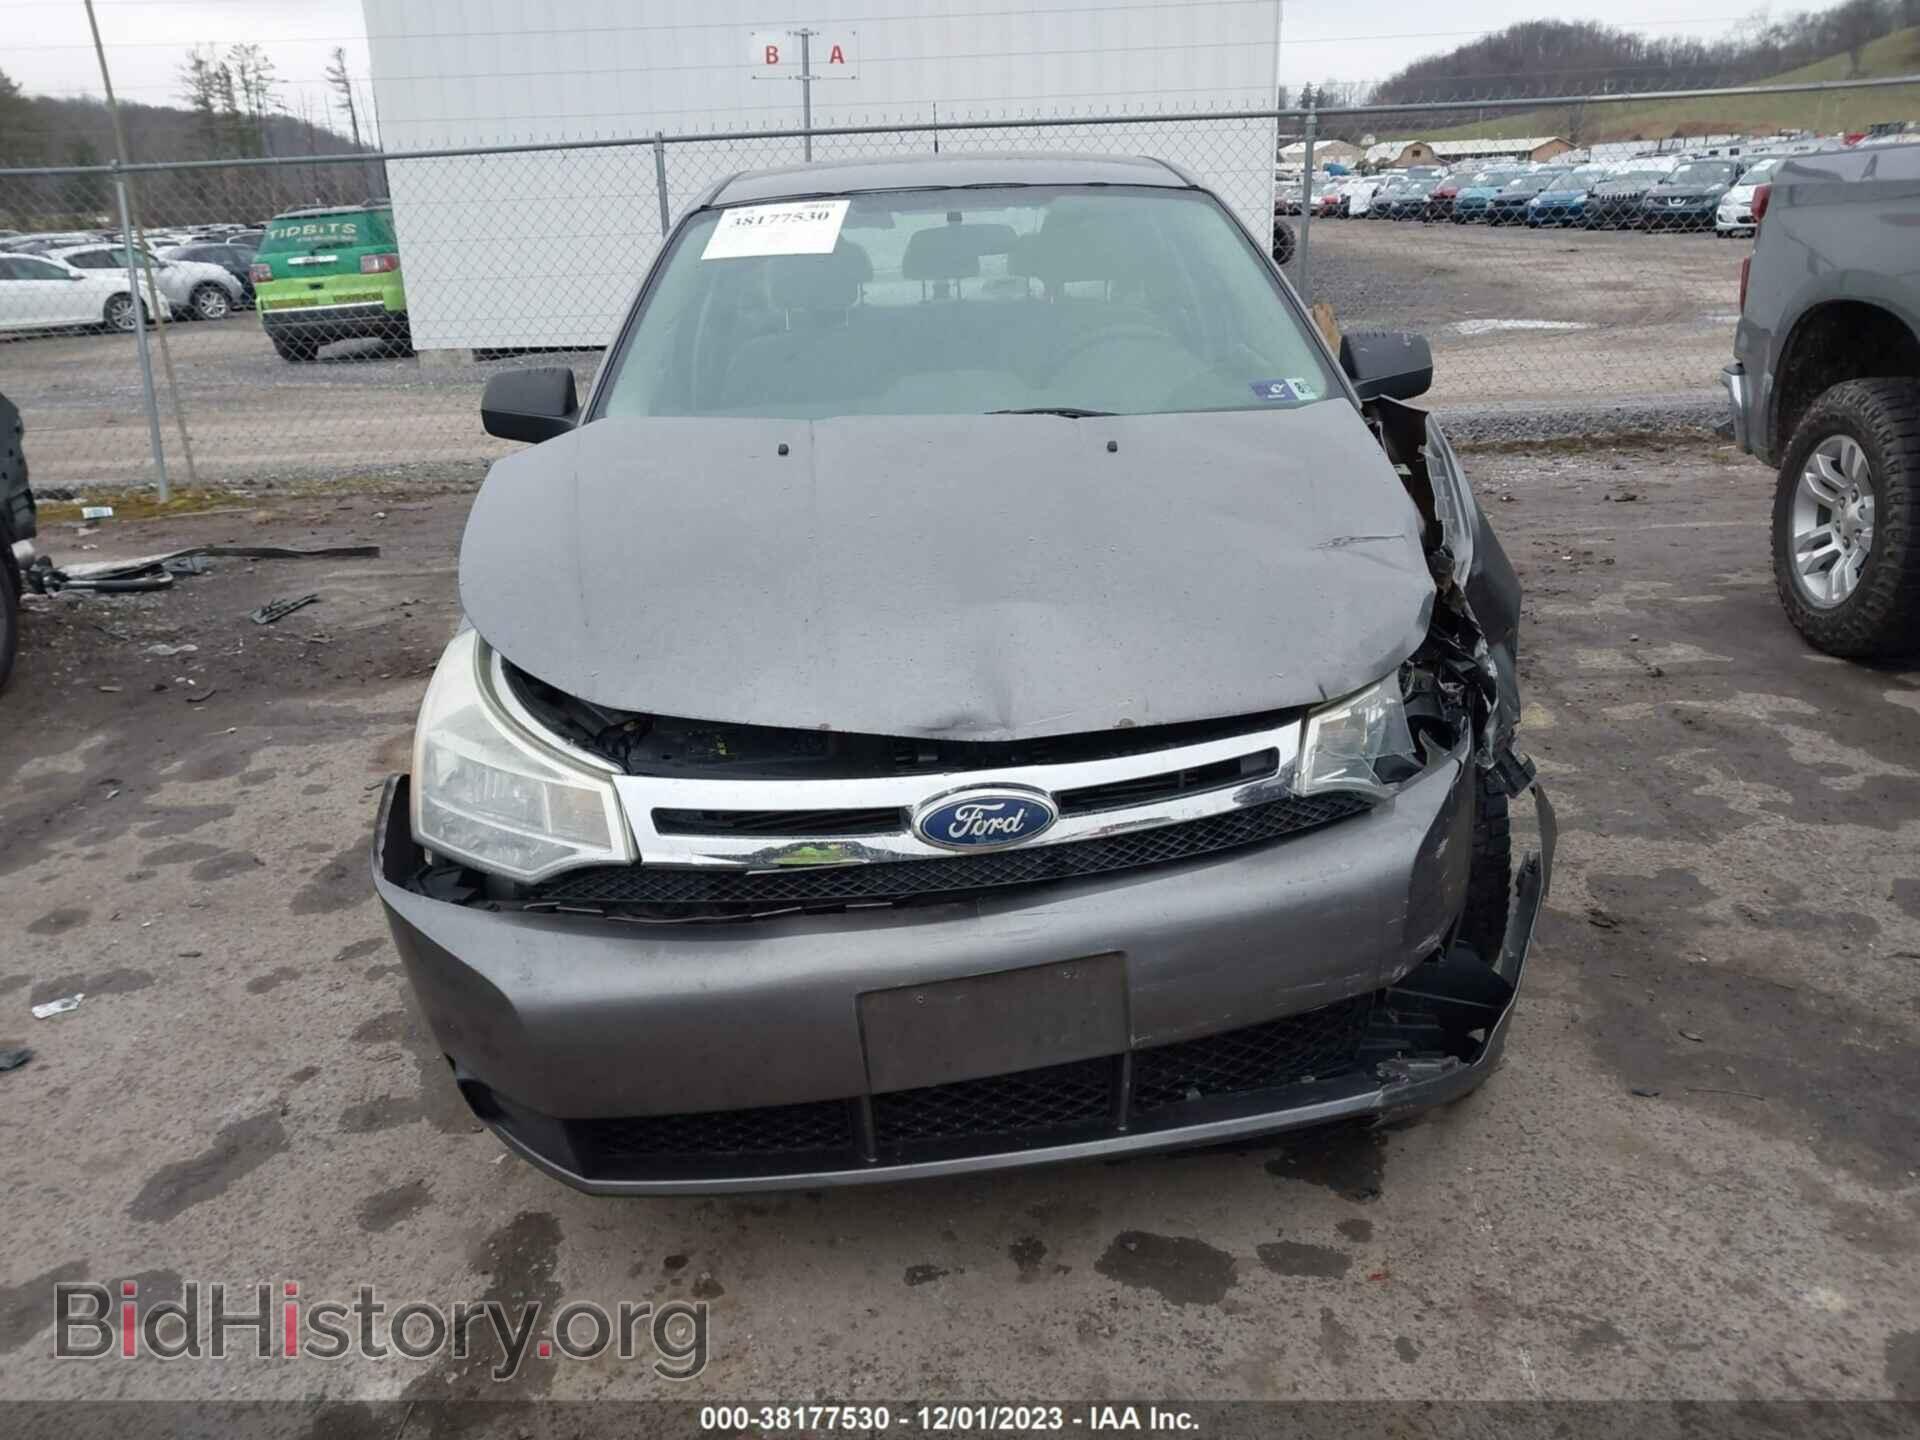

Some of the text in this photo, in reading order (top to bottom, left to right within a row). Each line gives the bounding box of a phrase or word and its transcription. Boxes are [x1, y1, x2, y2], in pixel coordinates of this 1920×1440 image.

[765, 45, 779, 65] B
[829, 44, 845, 65] A
[949, 803, 1025, 838] Ford
